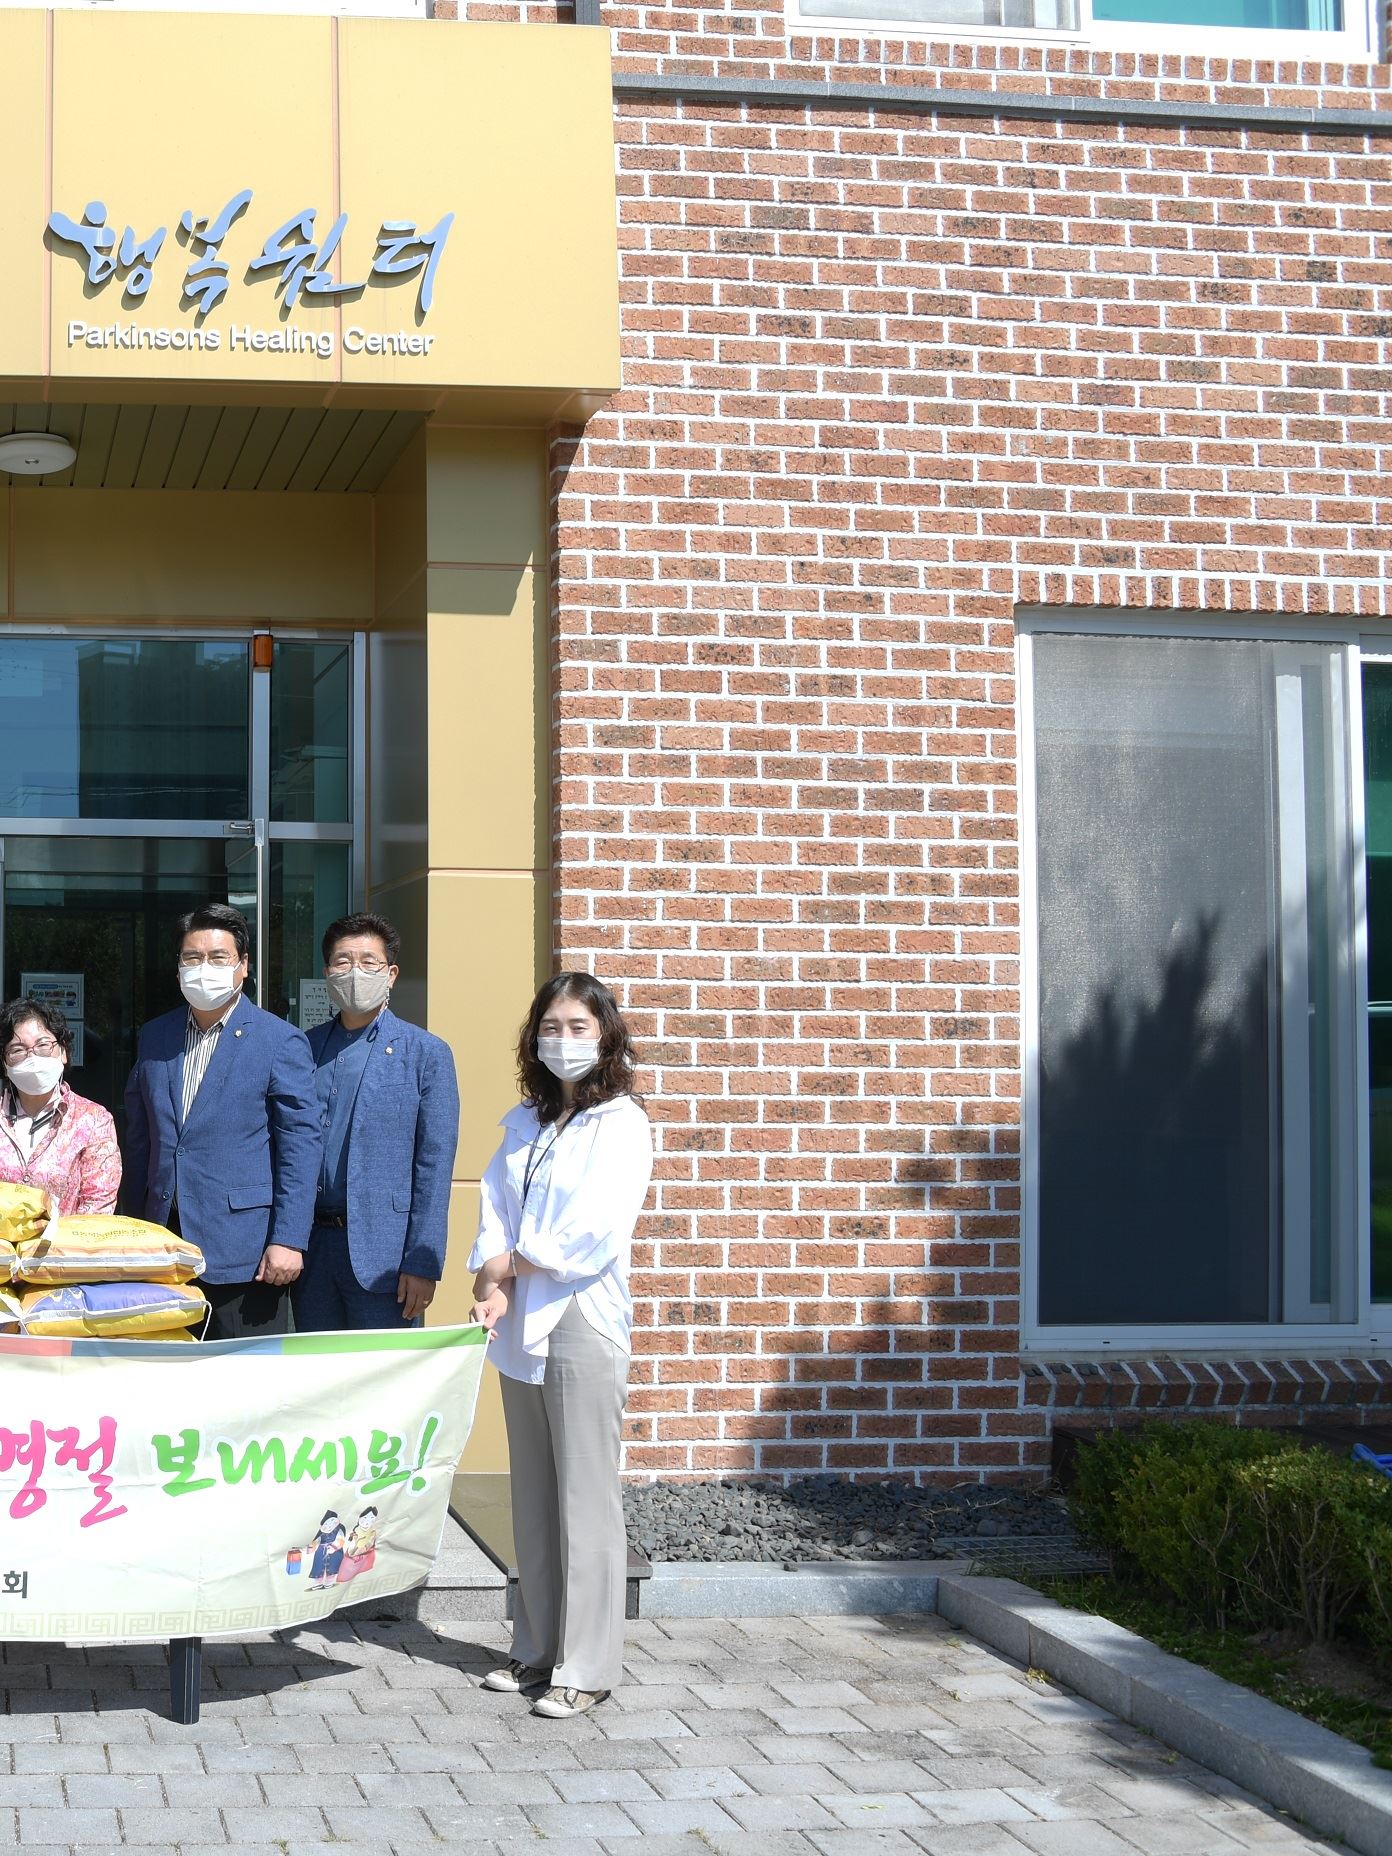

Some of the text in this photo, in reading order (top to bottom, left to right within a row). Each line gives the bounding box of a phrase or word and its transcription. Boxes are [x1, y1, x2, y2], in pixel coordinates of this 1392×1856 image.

[67, 320, 435, 357] Parkinsons Healing Center
[151, 1416, 439, 1497] 보내세요!
